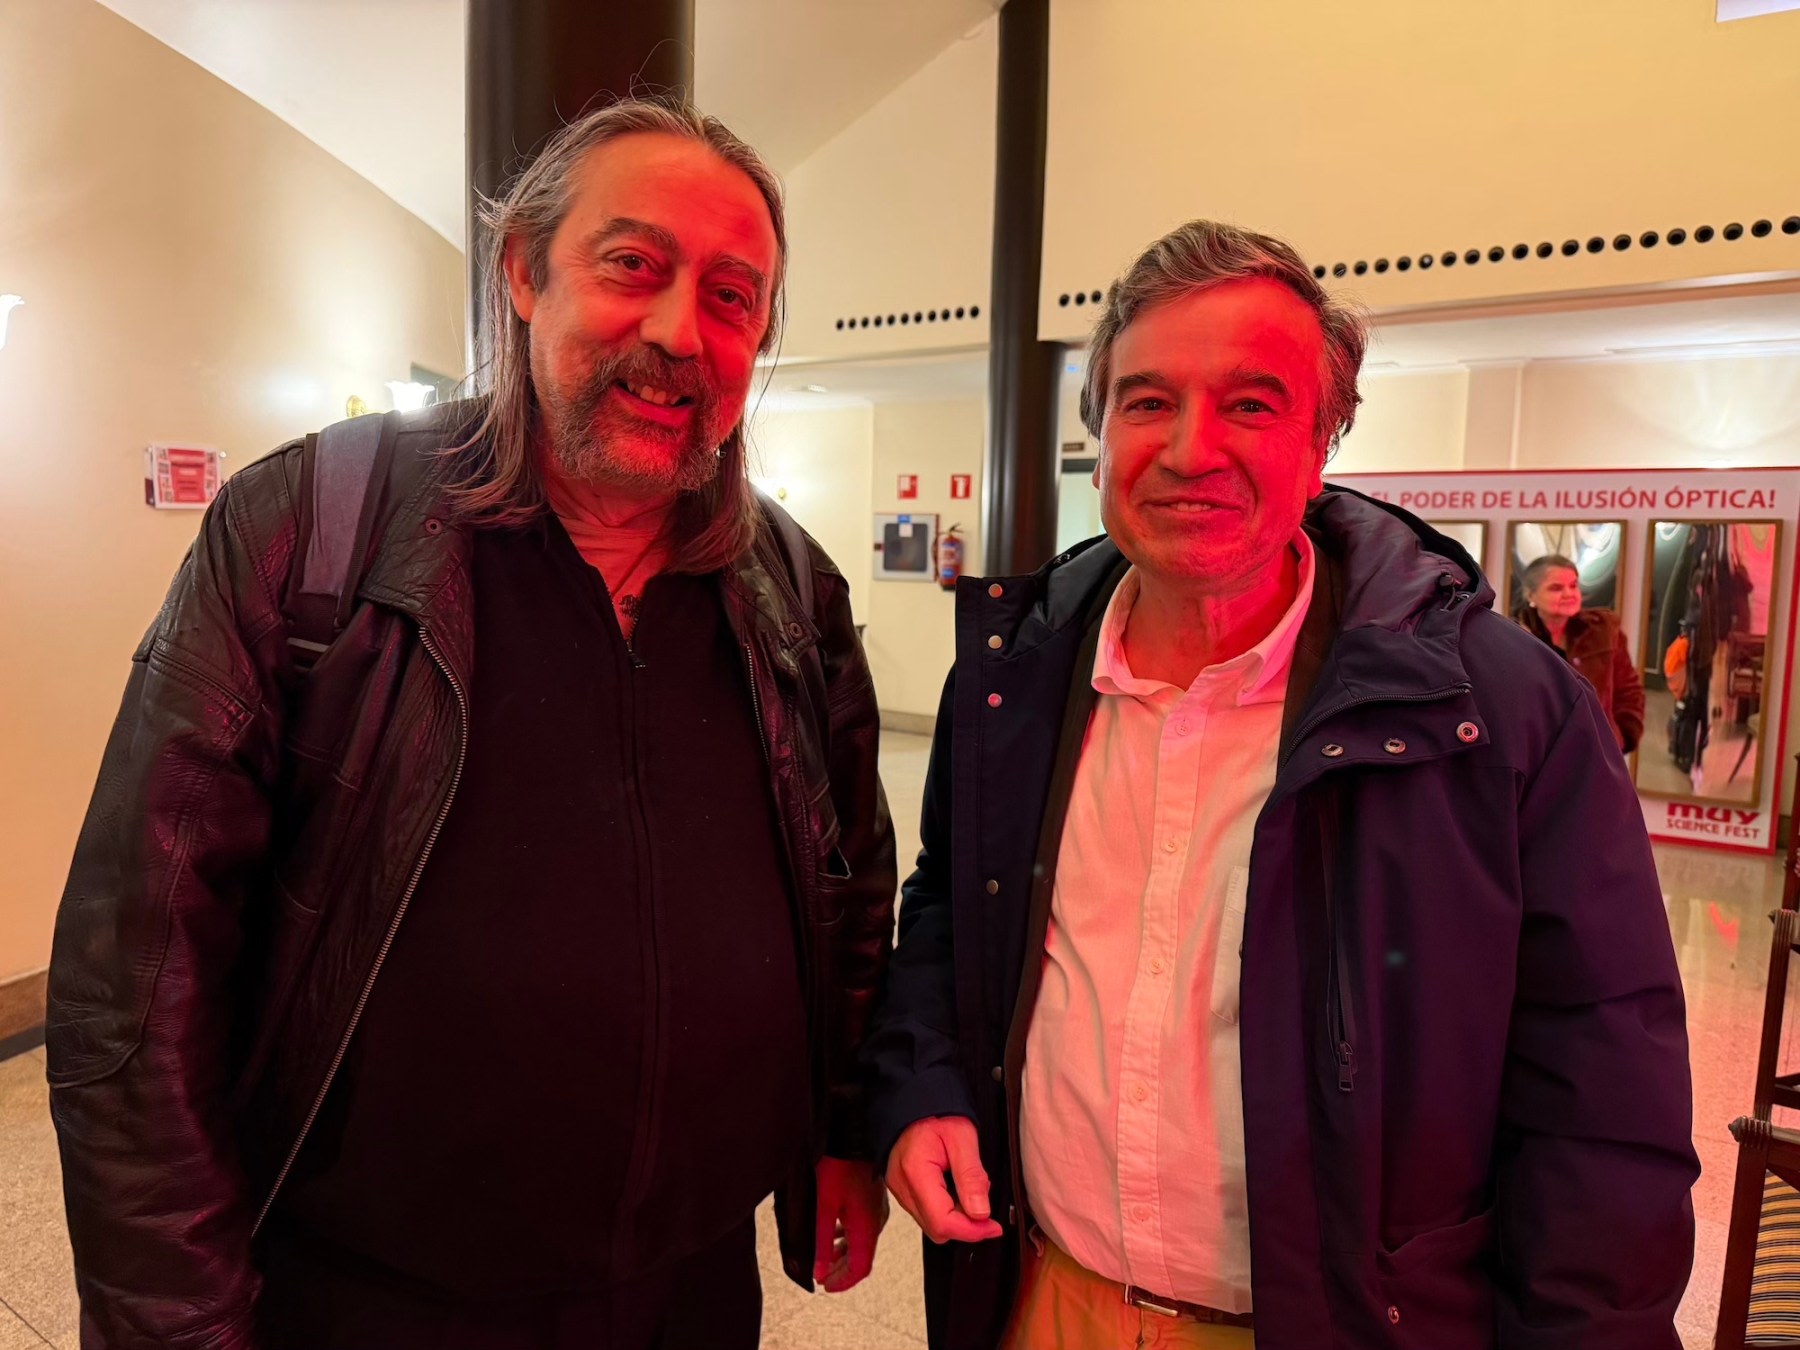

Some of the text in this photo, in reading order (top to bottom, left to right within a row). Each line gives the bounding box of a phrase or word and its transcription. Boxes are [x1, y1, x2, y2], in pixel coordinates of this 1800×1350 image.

[1400, 491, 1475, 509] PODER
[1482, 491, 1513, 509] DE
[1519, 491, 1547, 509] LA
[1555, 486, 1657, 509] ILUSIÓN
[1664, 485, 1776, 509] ÓPTICA!
[1667, 819, 1760, 839] SCIENCE FEST
